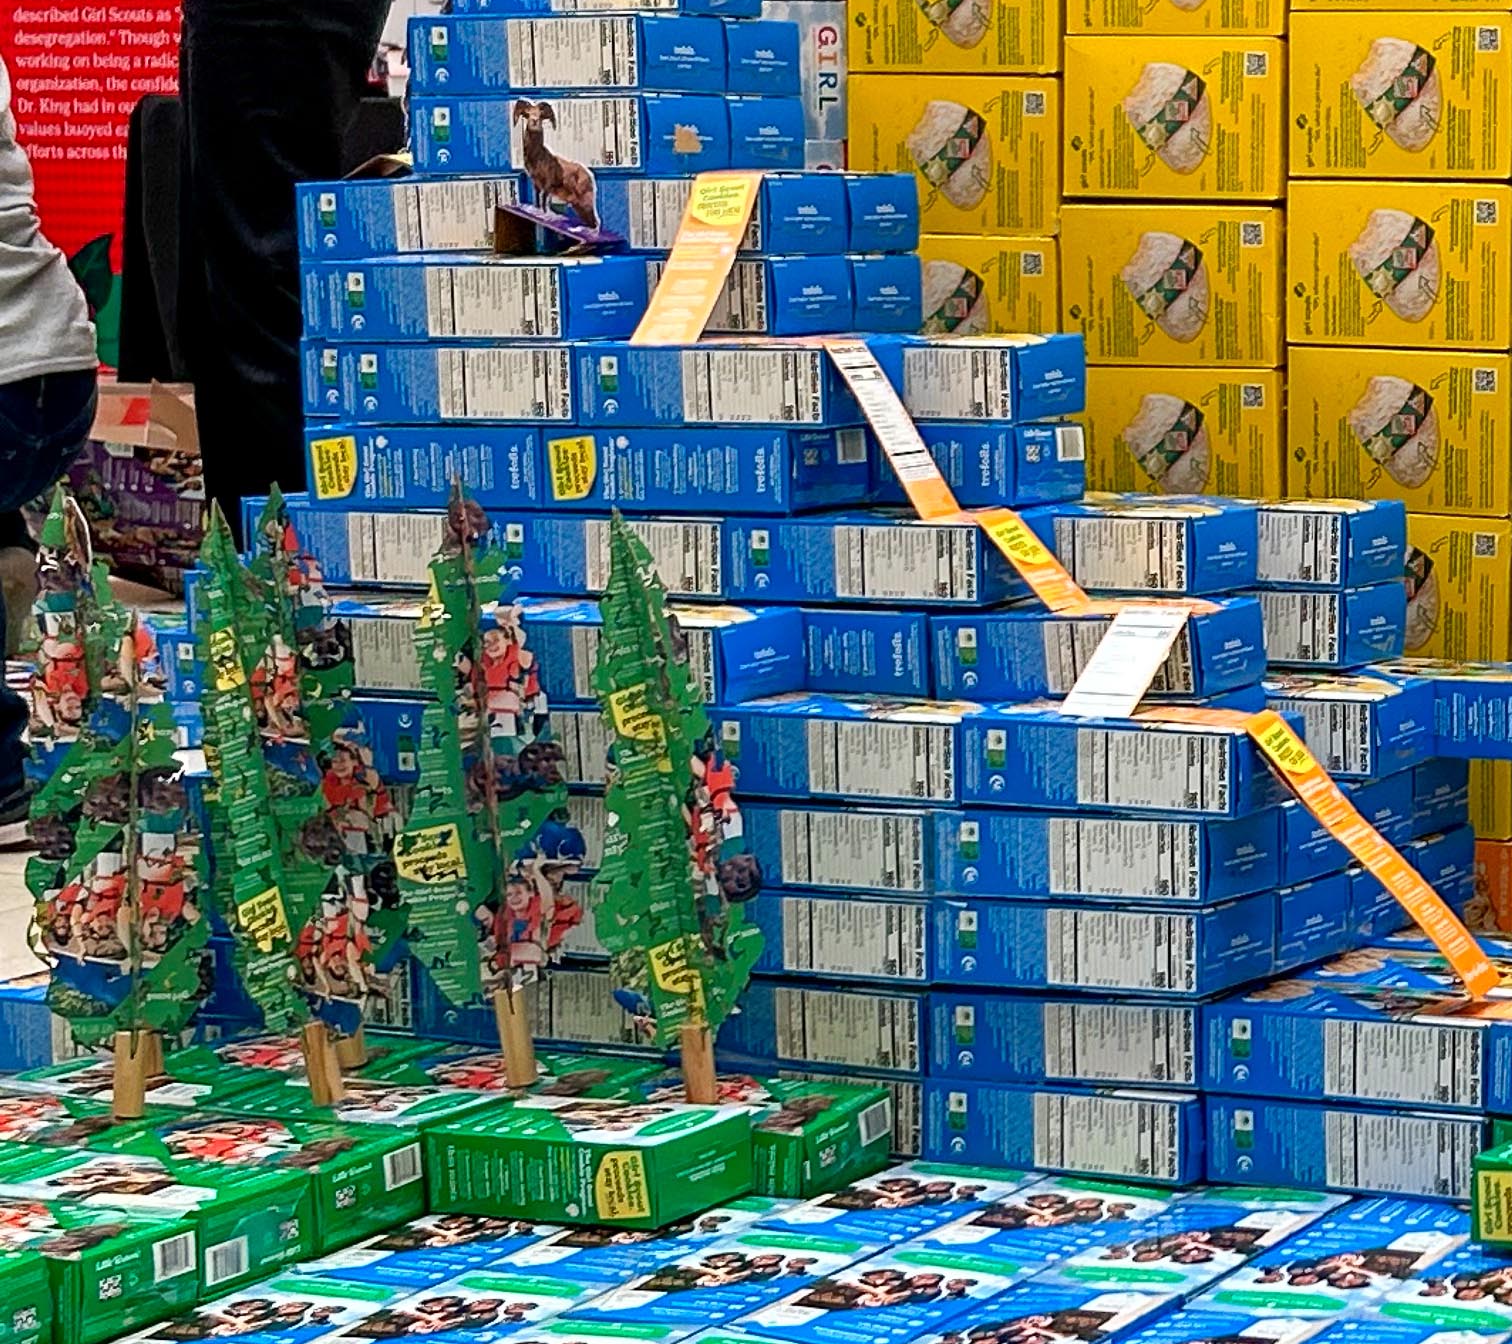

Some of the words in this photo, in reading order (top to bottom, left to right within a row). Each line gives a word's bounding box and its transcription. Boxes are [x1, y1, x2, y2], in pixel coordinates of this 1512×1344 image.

[13, 7, 79, 23] described
[118, 31, 169, 47] Though
[16, 54, 70, 71] working
[93, 53, 130, 70] being
